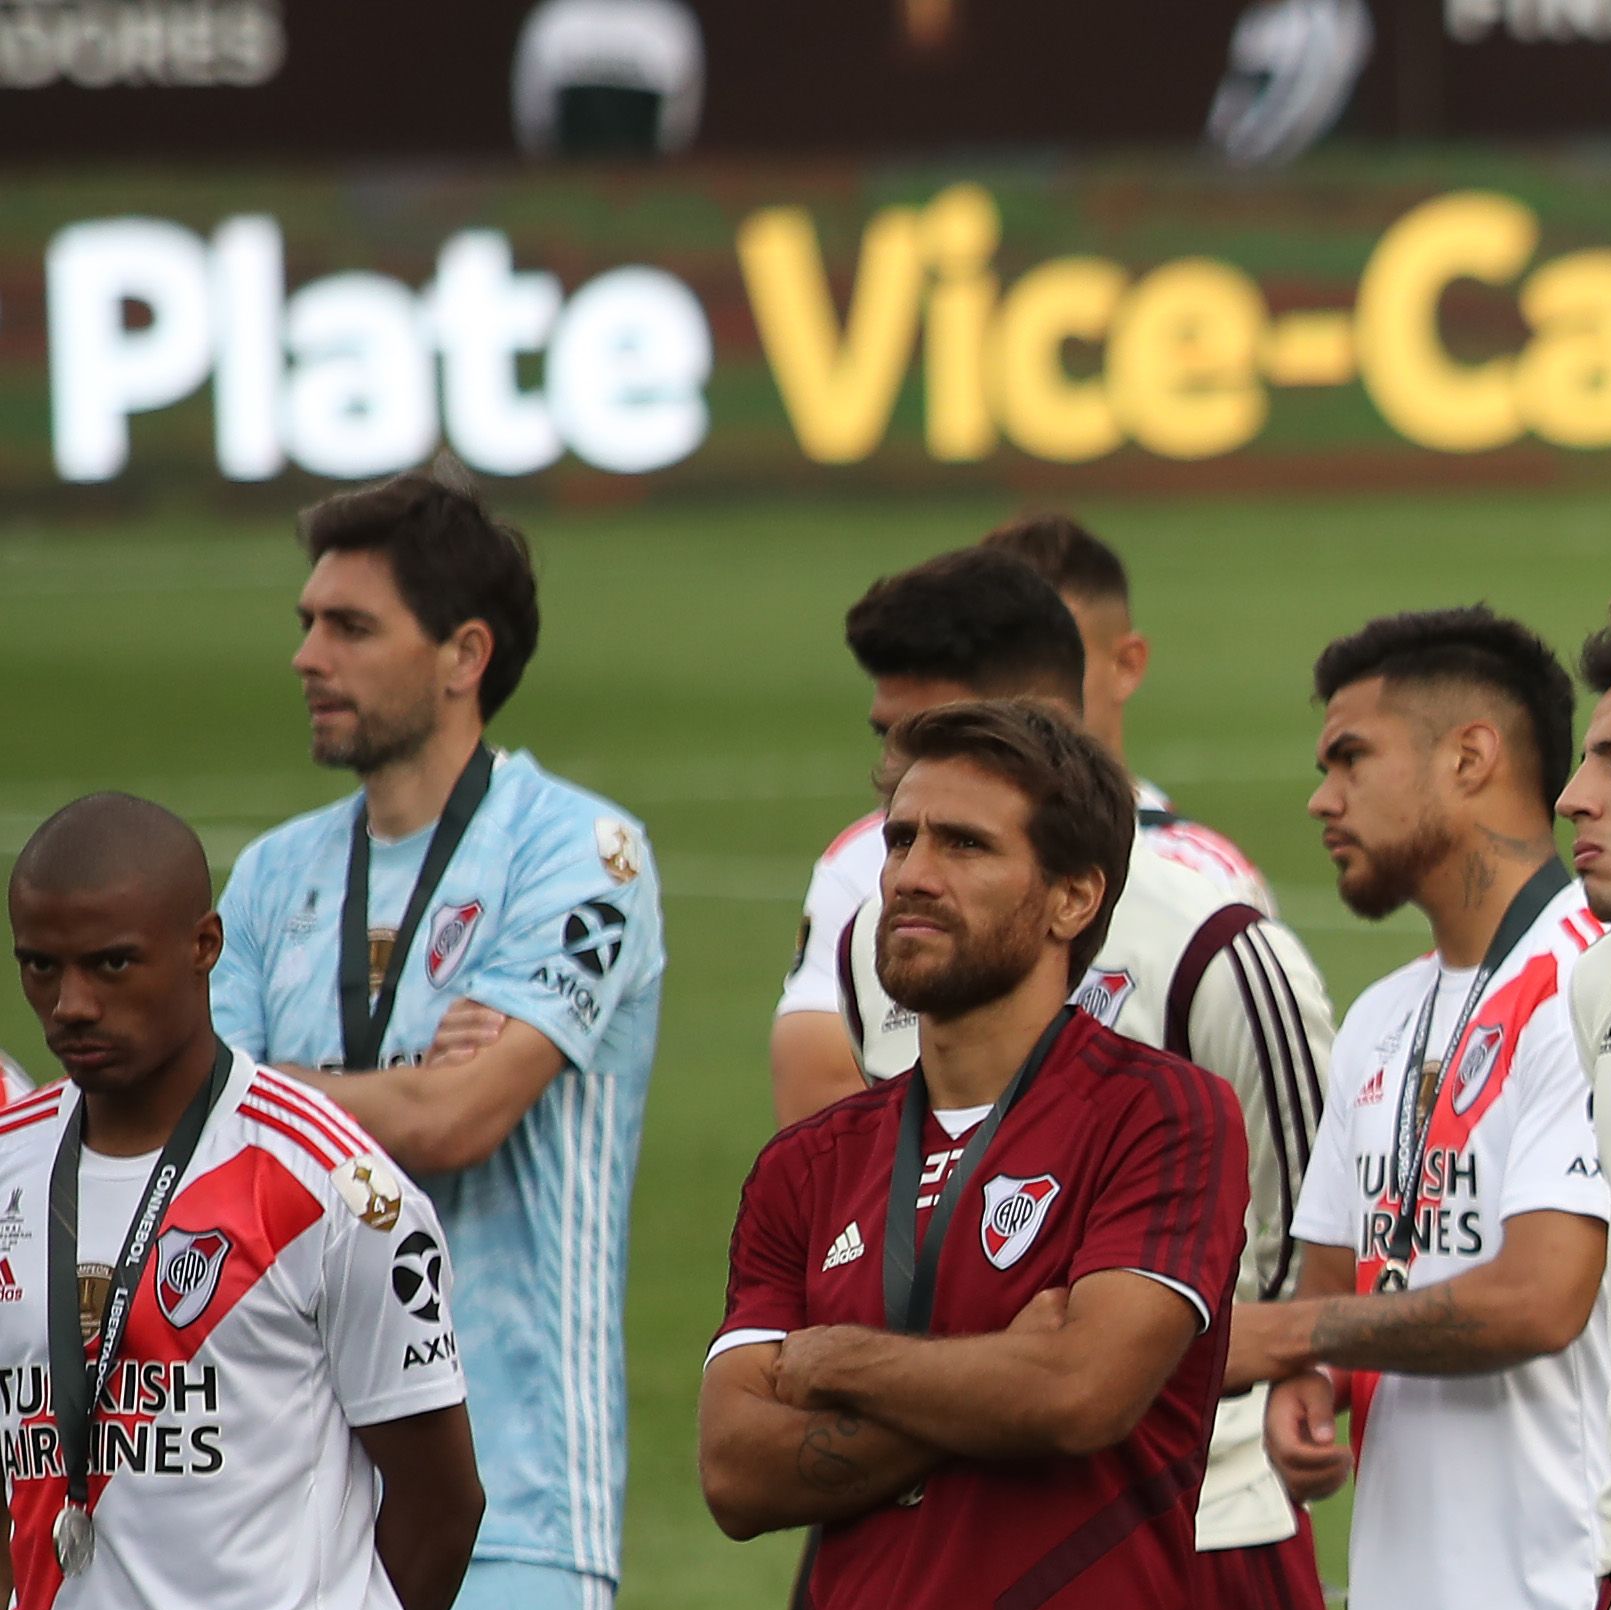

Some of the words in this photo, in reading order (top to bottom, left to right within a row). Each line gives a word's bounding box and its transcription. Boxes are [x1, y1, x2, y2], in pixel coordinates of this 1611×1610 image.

[45, 212, 714, 482] Plate
[125, 1164, 177, 1268] CONMEBOL
[0, 1361, 220, 1415] TUKISH
[3, 1421, 225, 1480] AIRINES
